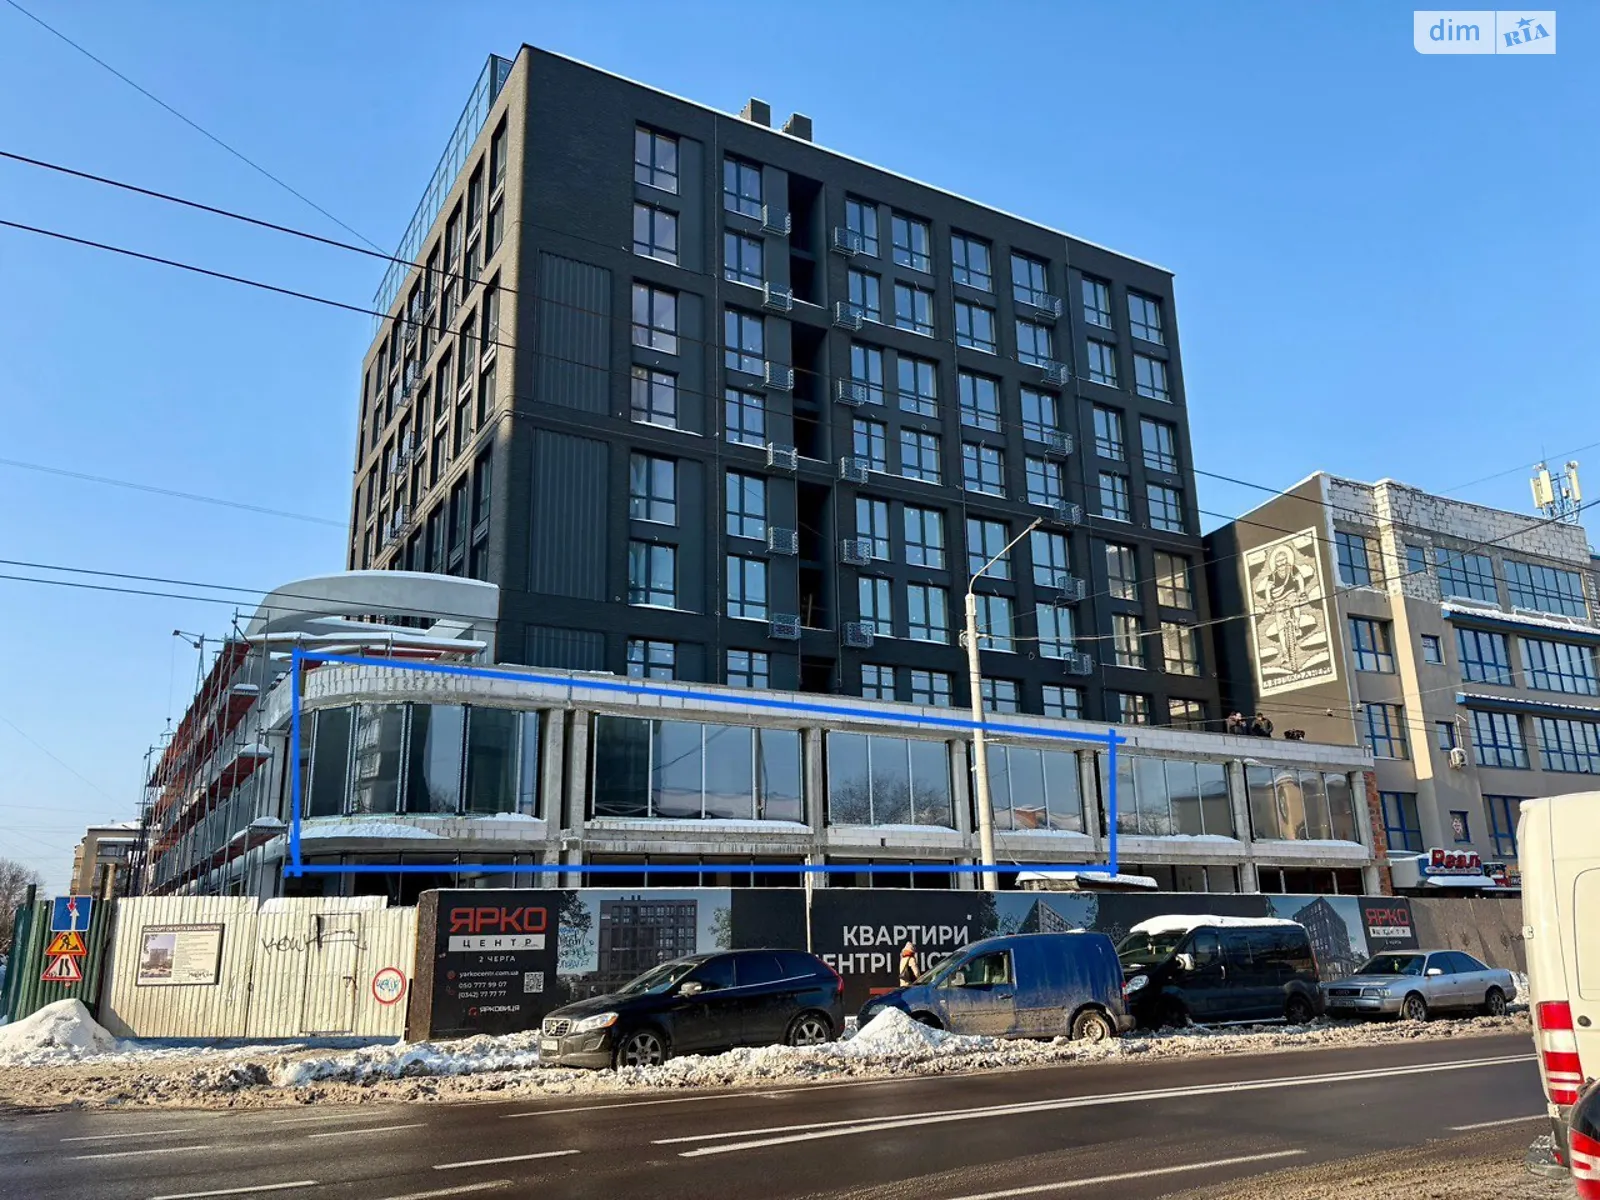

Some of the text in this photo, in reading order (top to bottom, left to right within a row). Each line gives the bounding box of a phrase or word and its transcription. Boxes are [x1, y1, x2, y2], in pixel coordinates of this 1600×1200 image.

[449, 907, 547, 932] ЯРКО
[1365, 908, 1410, 926] ЯРКО
[463, 938, 532, 949] ЦЕНТР
[843, 925, 969, 947] КВАРТИРИ
[815, 952, 892, 975] ЕНТРІ
